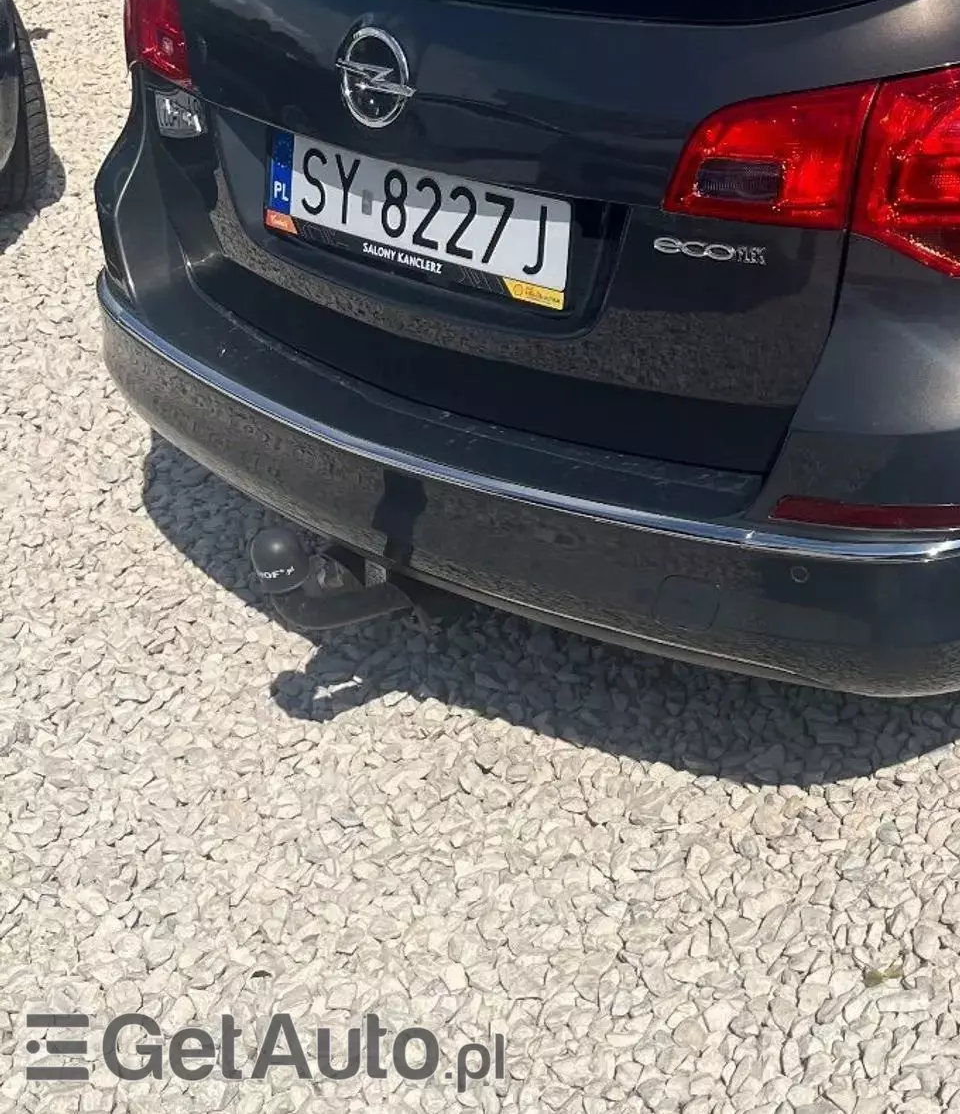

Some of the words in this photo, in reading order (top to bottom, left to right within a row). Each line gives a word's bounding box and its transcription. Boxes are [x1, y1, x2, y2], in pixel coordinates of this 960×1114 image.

[273, 180, 290, 202] PL
[301, 148, 361, 224] SY
[381, 168, 548, 275] 8227J
[362, 241, 397, 262] SALONY
[396, 252, 442, 275] KANCLERZ
